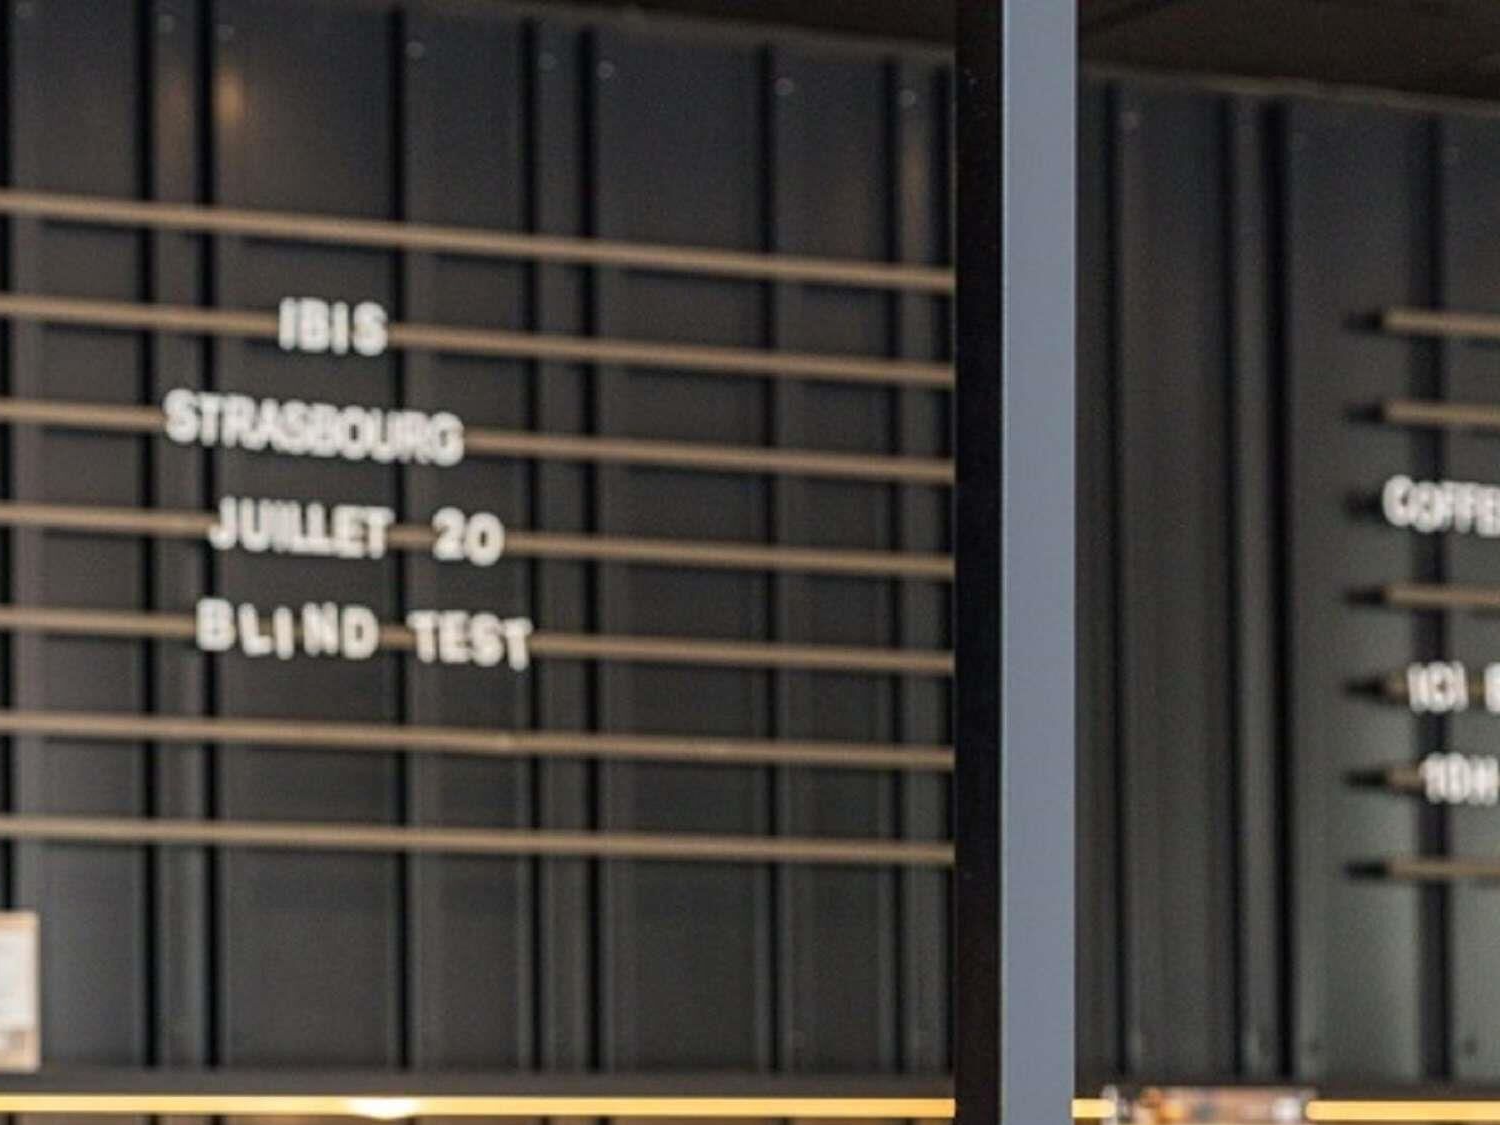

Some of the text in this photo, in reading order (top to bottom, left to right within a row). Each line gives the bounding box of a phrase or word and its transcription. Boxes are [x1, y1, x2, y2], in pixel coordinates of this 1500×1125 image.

[278, 297, 389, 356] IBIS
[164, 389, 466, 466] STRASBOURG
[208, 496, 505, 566] JUILLET 20
[196, 598, 532, 671] BLIND TEST
